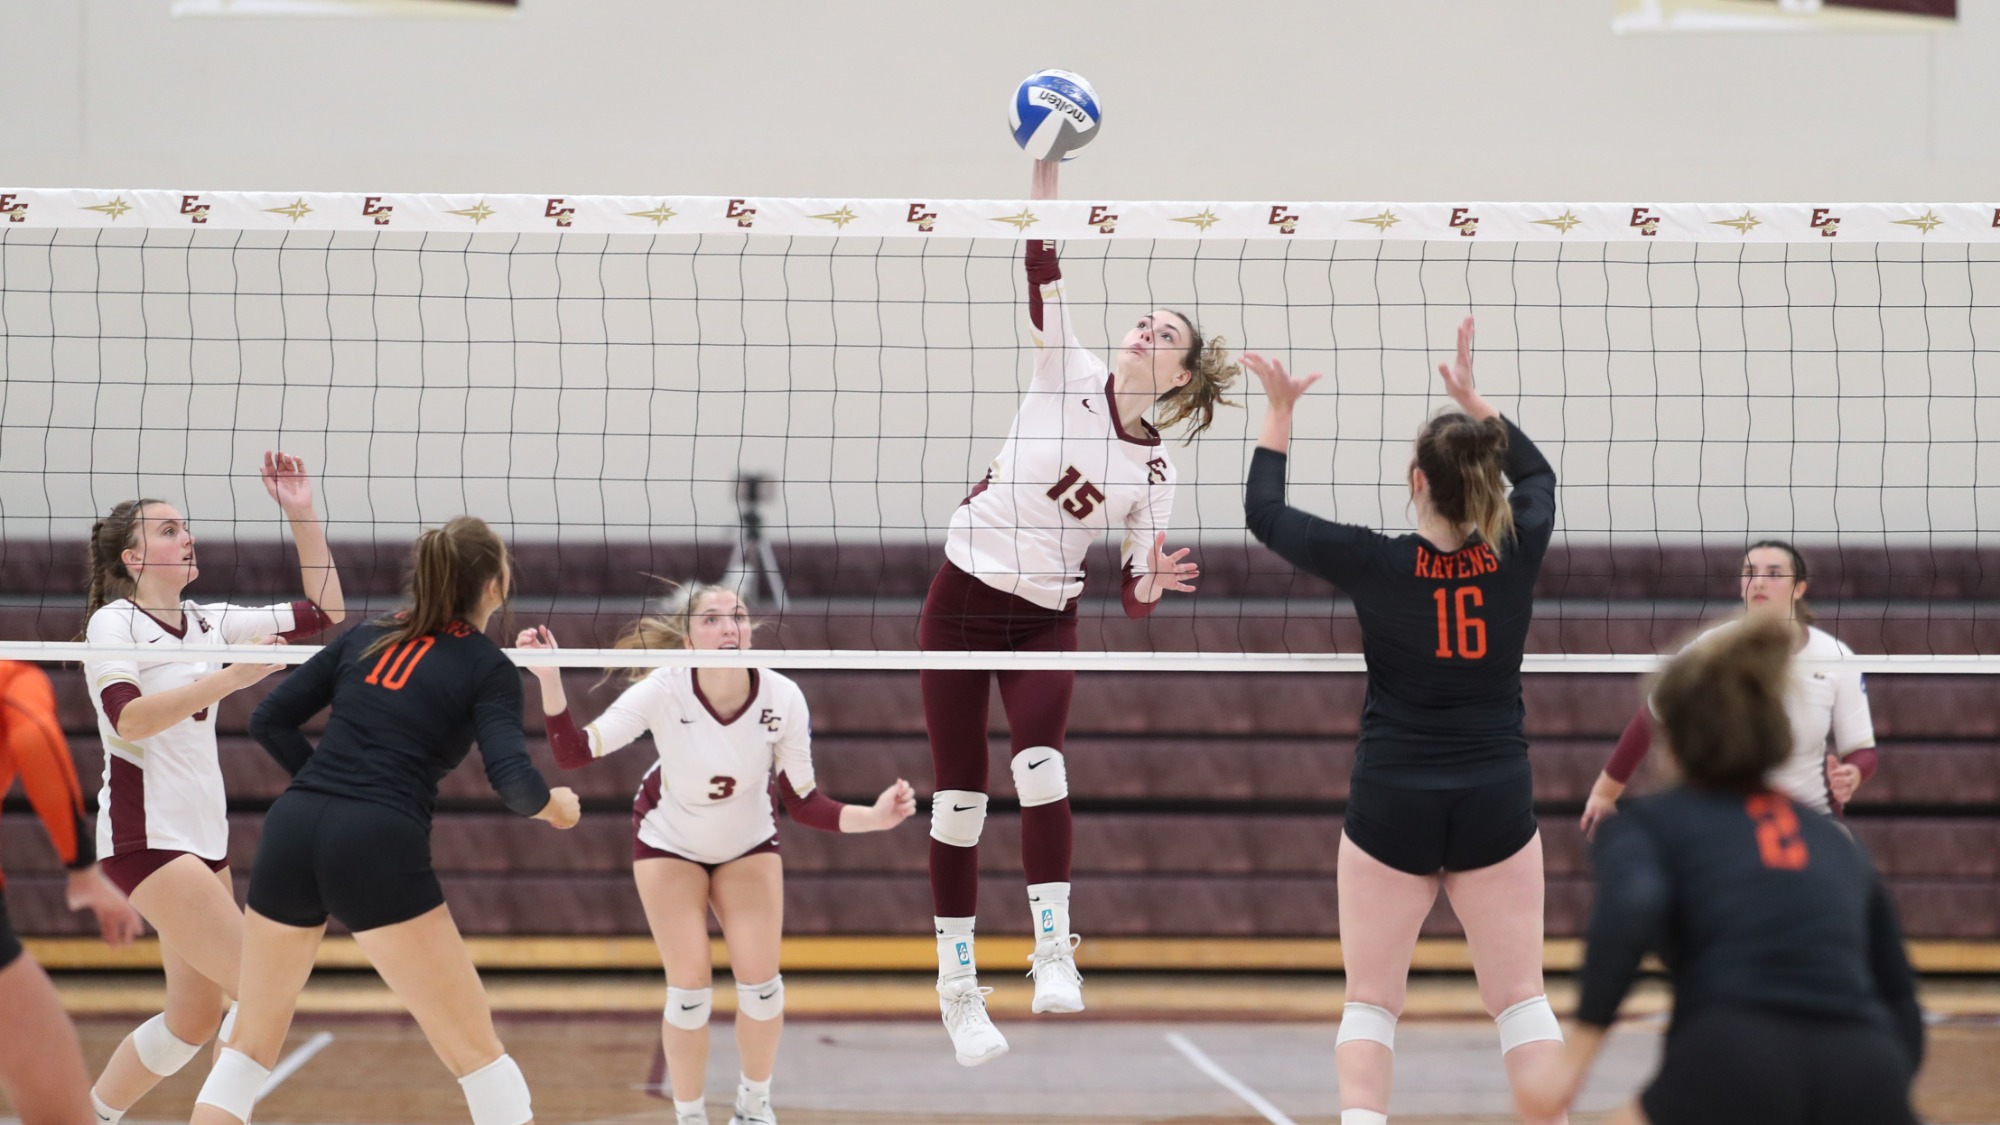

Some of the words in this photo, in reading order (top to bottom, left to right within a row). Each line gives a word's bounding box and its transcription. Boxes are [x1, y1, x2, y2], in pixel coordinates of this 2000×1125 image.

[1038, 90, 1086, 123] molten
[1046, 465, 1106, 520] 15
[1415, 542, 1498, 579] RAVENS
[1433, 585, 1487, 659] 16
[364, 635, 435, 691] 10
[708, 775, 736, 800] 3
[1745, 792, 1810, 870] 2
